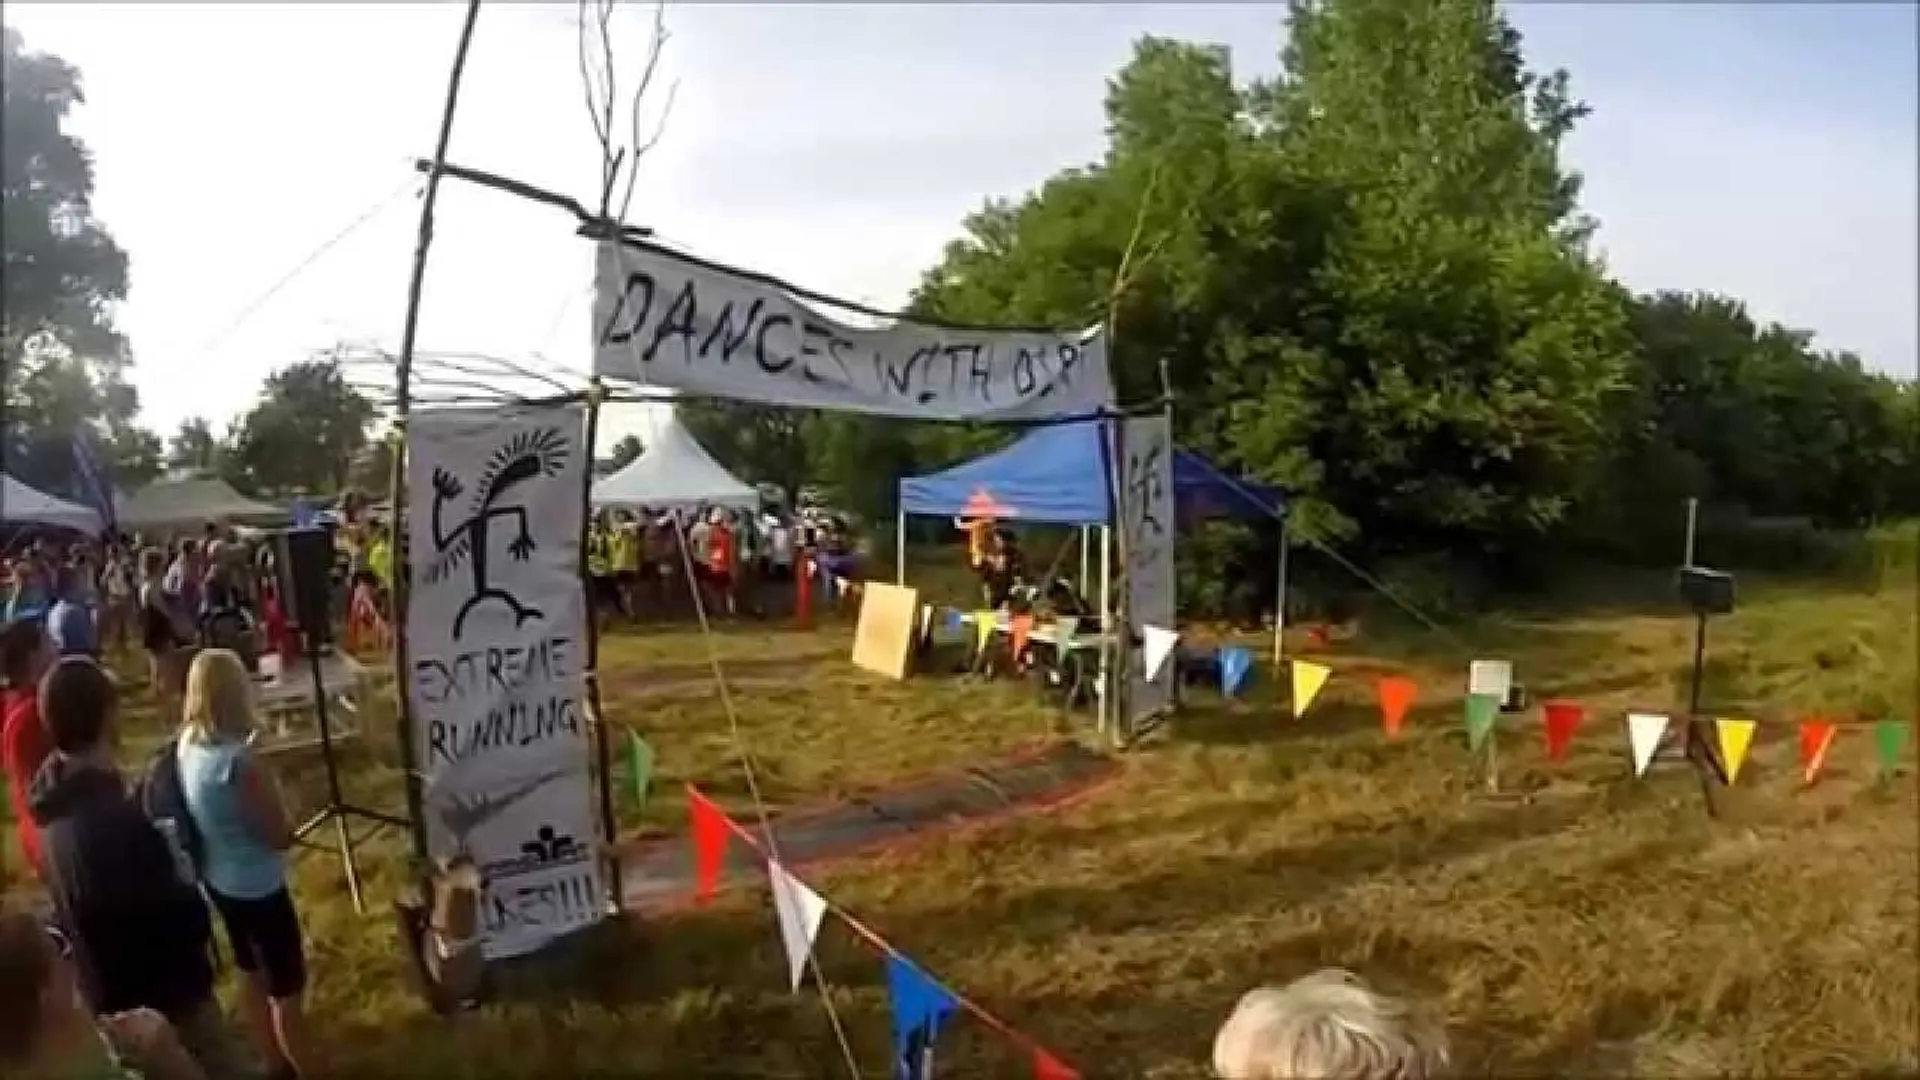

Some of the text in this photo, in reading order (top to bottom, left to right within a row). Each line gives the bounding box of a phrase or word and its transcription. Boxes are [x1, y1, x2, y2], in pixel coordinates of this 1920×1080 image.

[601, 271, 854, 382] DANCES
[873, 341, 995, 404] WITH
[416, 636, 573, 700] EXTREME
[429, 696, 579, 766] RUNNING
